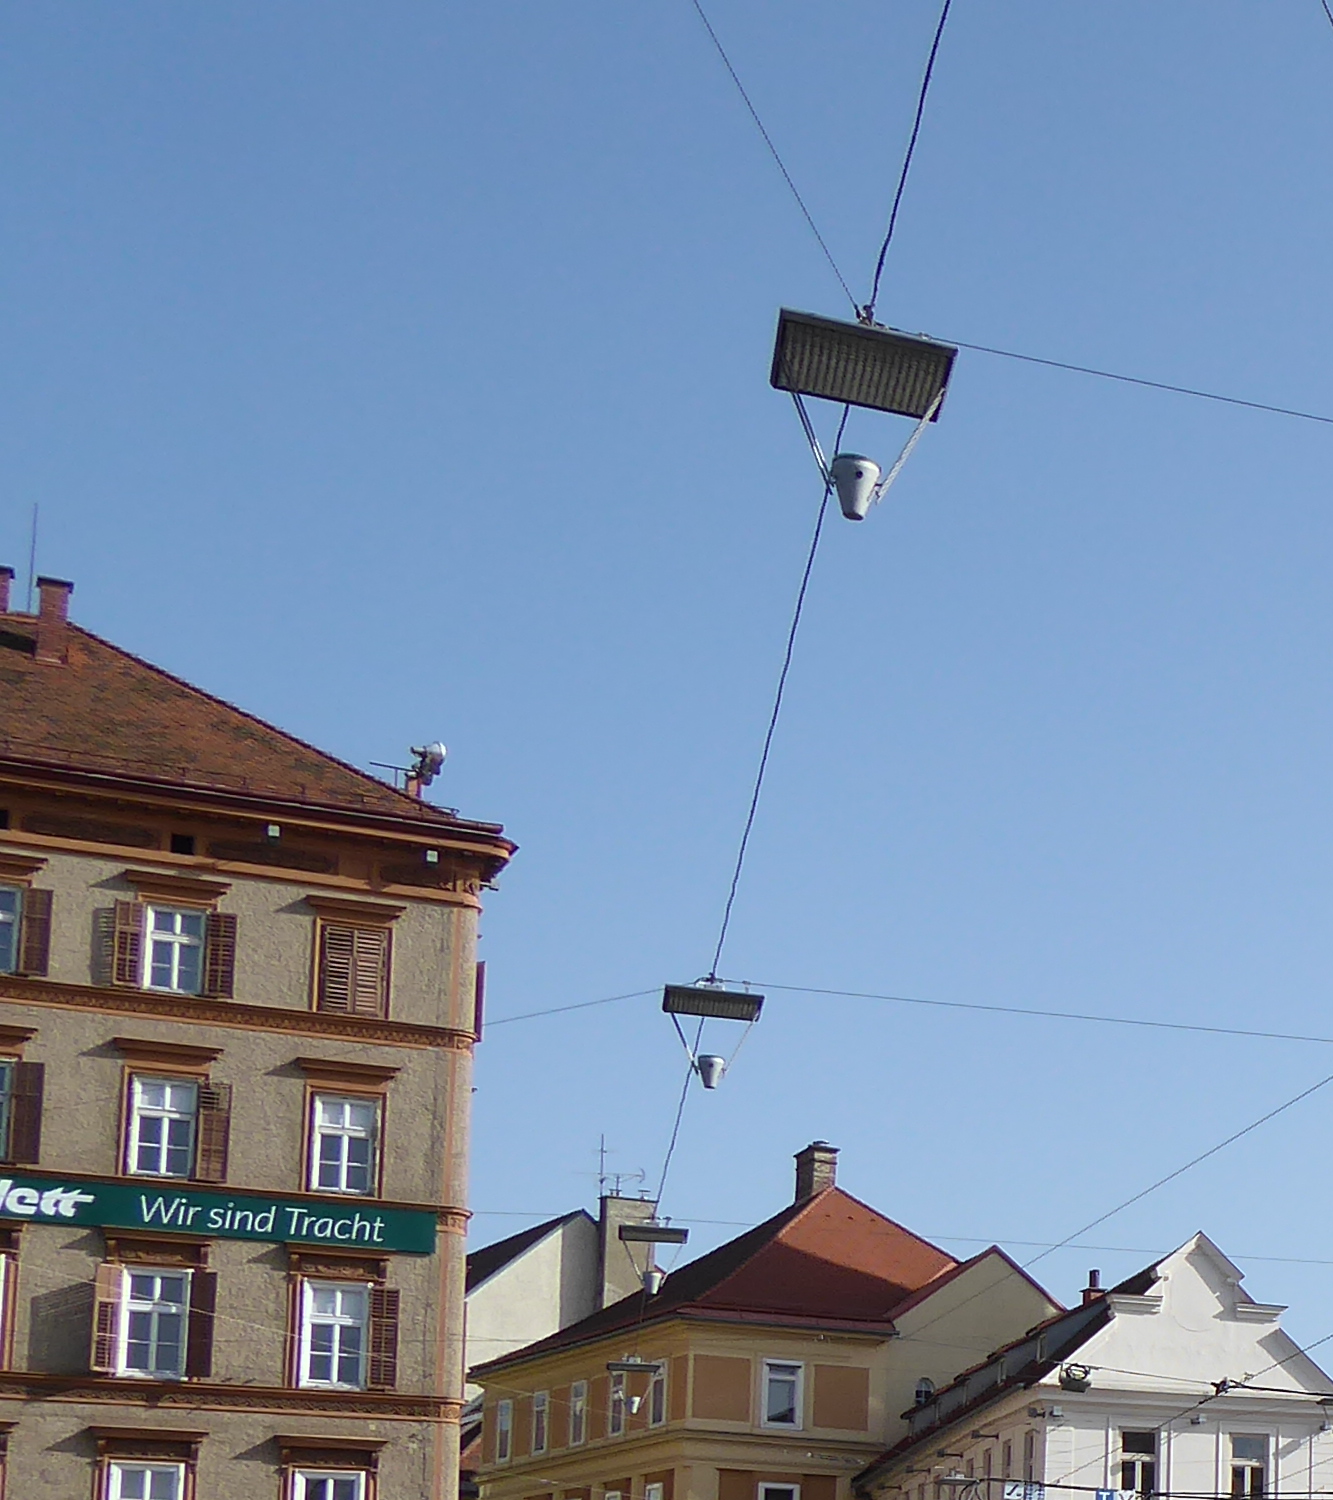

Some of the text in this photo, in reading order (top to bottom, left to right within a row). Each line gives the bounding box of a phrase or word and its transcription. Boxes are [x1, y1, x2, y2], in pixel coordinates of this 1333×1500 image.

[140, 1194, 201, 1226] Wir
[207, 1202, 277, 1233] sind
[285, 1207, 385, 1242] Tracht
